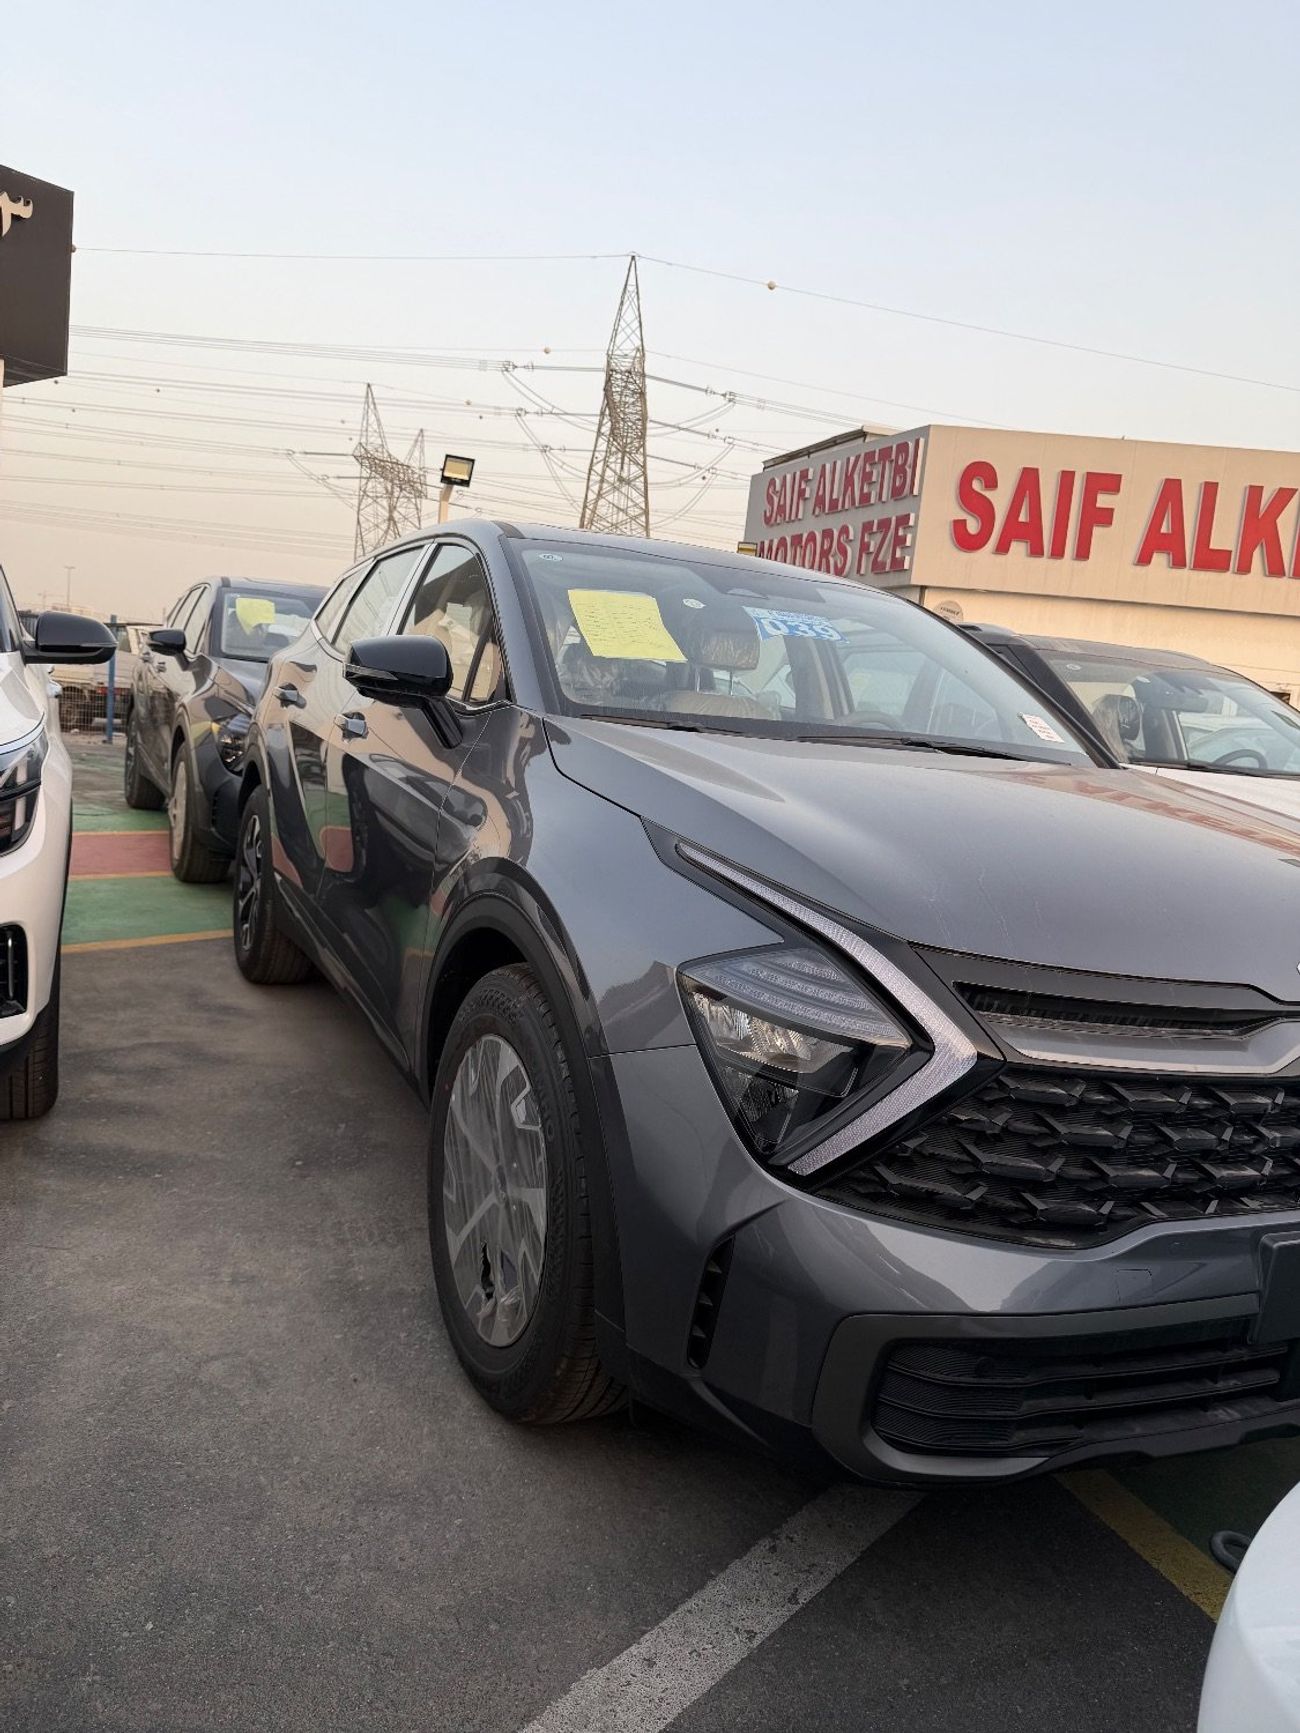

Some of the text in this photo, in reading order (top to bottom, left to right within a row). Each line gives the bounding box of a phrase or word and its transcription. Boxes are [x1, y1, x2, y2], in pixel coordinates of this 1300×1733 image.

[763, 437, 925, 528] SAIF ALKETBI
[952, 460, 1300, 580] SAIF ALK
[857, 513, 915, 576] FZE
